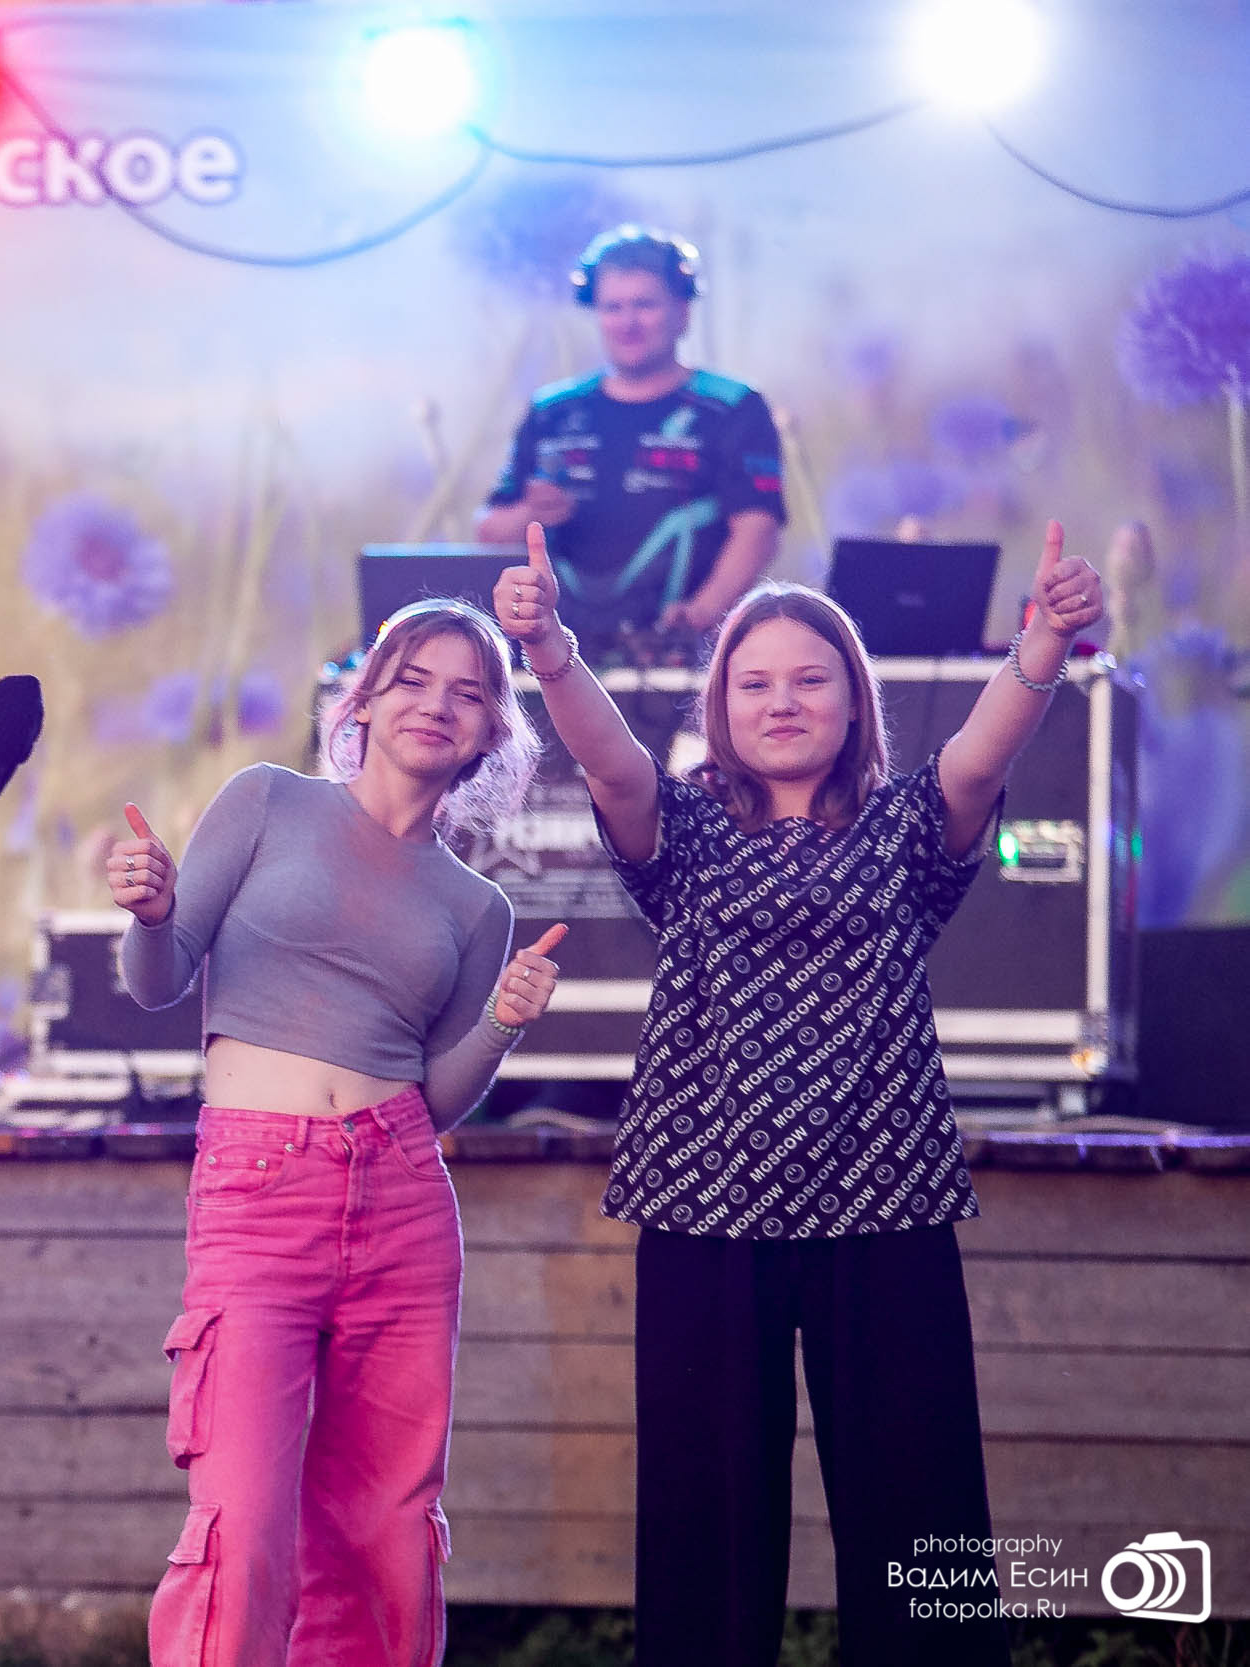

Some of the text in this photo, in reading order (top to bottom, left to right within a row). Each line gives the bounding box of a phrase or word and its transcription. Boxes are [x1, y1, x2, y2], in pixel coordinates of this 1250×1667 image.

[830, 835, 873, 883] MOSCOW
[718, 874, 779, 923] MOSCOW
[810, 883, 865, 939] MOSCOW
[750, 906, 811, 958] MOSCOW
[729, 957, 787, 1008] MOSCOW
[785, 936, 846, 992] MOSCOW
[888, 956, 927, 1018] MOSCOW
[762, 991, 821, 1044] MOSCOW
[820, 967, 877, 1026] MOSCOW
[737, 1044, 798, 1095] MOSCOW
[797, 1022, 857, 1075] MOSCOW
[831, 1041, 876, 1103] MOSCOW
[874, 1013, 920, 1076] MOSCOW
[644, 1082, 700, 1133] MOSCOW
[723, 1092, 774, 1149] MOSCOW
[772, 1075, 833, 1129] MOSCOW
[857, 1069, 910, 1131] MOSCOW
[627, 1131, 671, 1185] MOSCOW
[666, 1116, 725, 1169] MOSCOW
[749, 1125, 808, 1183] MOSCOW
[807, 1101, 859, 1161] MOSCOW
[894, 1100, 937, 1161] MOSCOW
[697, 1149, 750, 1206] MOSCOW
[784, 1156, 839, 1216] MOSCOW
[839, 1128, 893, 1191] MOSCOW
[641, 1168, 701, 1220] MOSCOW
[726, 1182, 785, 1239] MOSCOW
[877, 1159, 928, 1220] MOSCOW
